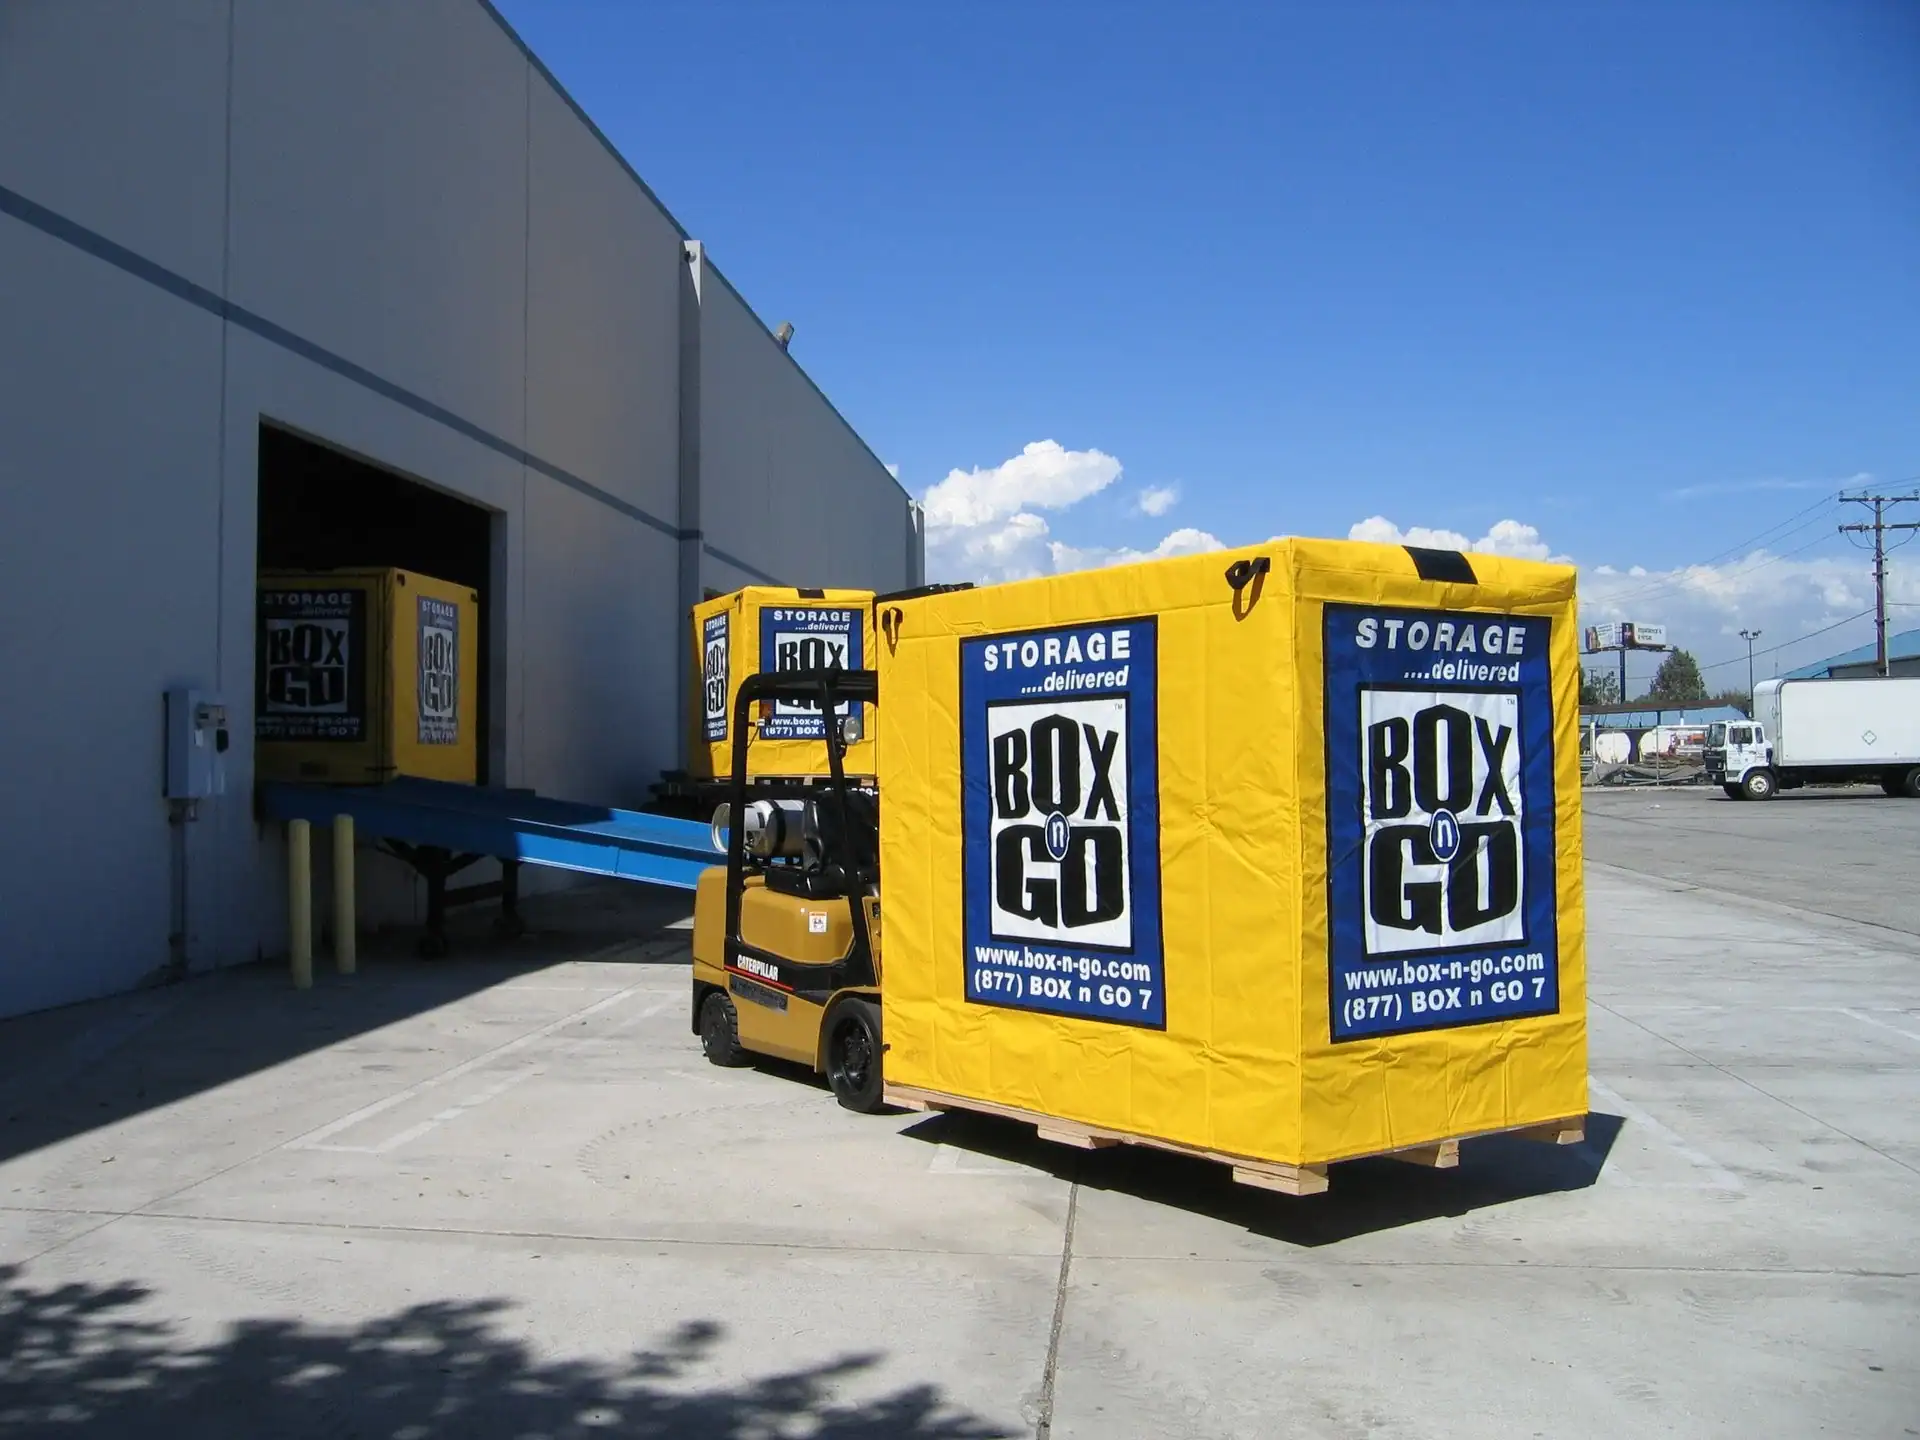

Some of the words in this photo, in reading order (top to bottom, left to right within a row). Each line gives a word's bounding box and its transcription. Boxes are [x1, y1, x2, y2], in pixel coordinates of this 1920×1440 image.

[773, 610, 851, 622] STORAGE
[1355, 617, 1527, 655] STORAGE
[269, 624, 345, 665] BOX
[424, 632, 452, 674] BOX
[984, 630, 1131, 672] STORAGE
[268, 666, 345, 707] GO
[765, 727, 793, 736] (877)
[796, 727, 819, 735] BOX
[993, 713, 1120, 820] BOX
[1368, 703, 1515, 820] BOX
[1052, 819, 1065, 849] n
[1437, 819, 1453, 848] n
[996, 824, 1125, 929] GO
[1369, 820, 1518, 935] GO
[737, 954, 779, 981] CATERPILLAR
[975, 945, 1151, 982] www.box-n-go.com
[1345, 950, 1544, 990] www.box-n-go.com
[974, 968, 1023, 998] (877)
[1029, 975, 1072, 1001] BOX
[1079, 983, 1091, 1002] n
[1099, 985, 1132, 1009] GO
[1139, 989, 1152, 1010] 7
[1343, 996, 1403, 1028] (877)
[1411, 987, 1462, 1014] BOX
[1470, 986, 1483, 1006] n
[1490, 978, 1524, 1003] GO
[1532, 976, 1545, 998] 7
